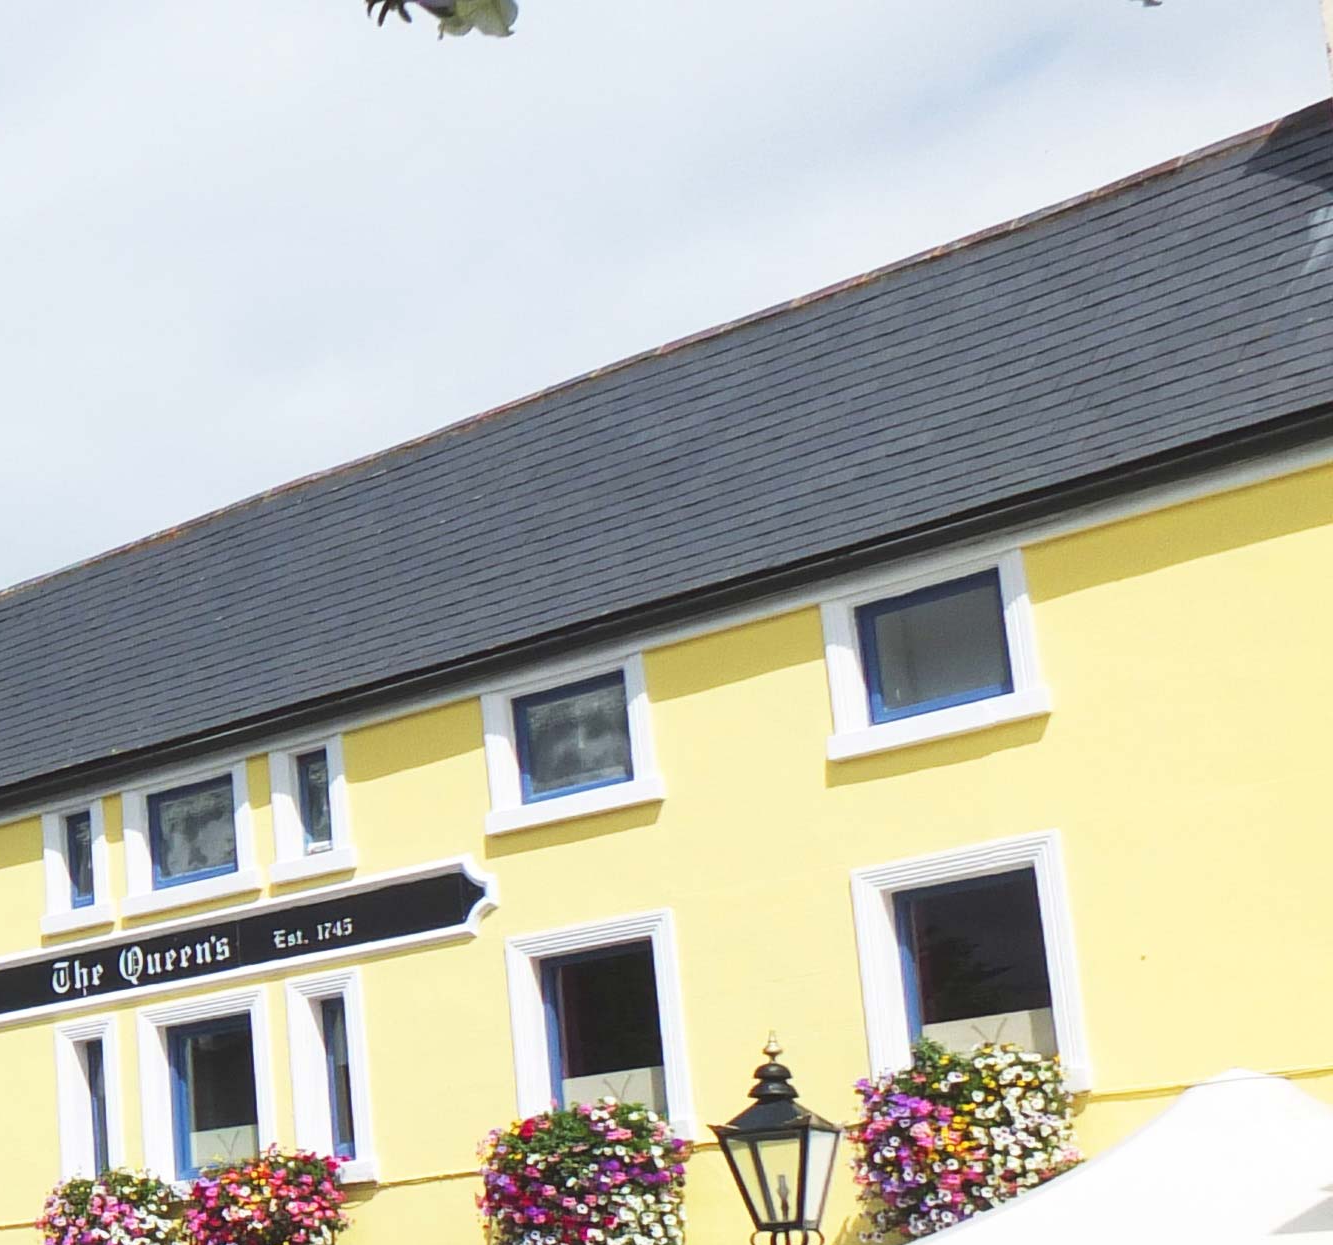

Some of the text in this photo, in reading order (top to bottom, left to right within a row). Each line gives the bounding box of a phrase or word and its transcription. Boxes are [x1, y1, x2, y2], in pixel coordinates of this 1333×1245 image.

[52, 918, 353, 995] The Queen's Est. 1745
